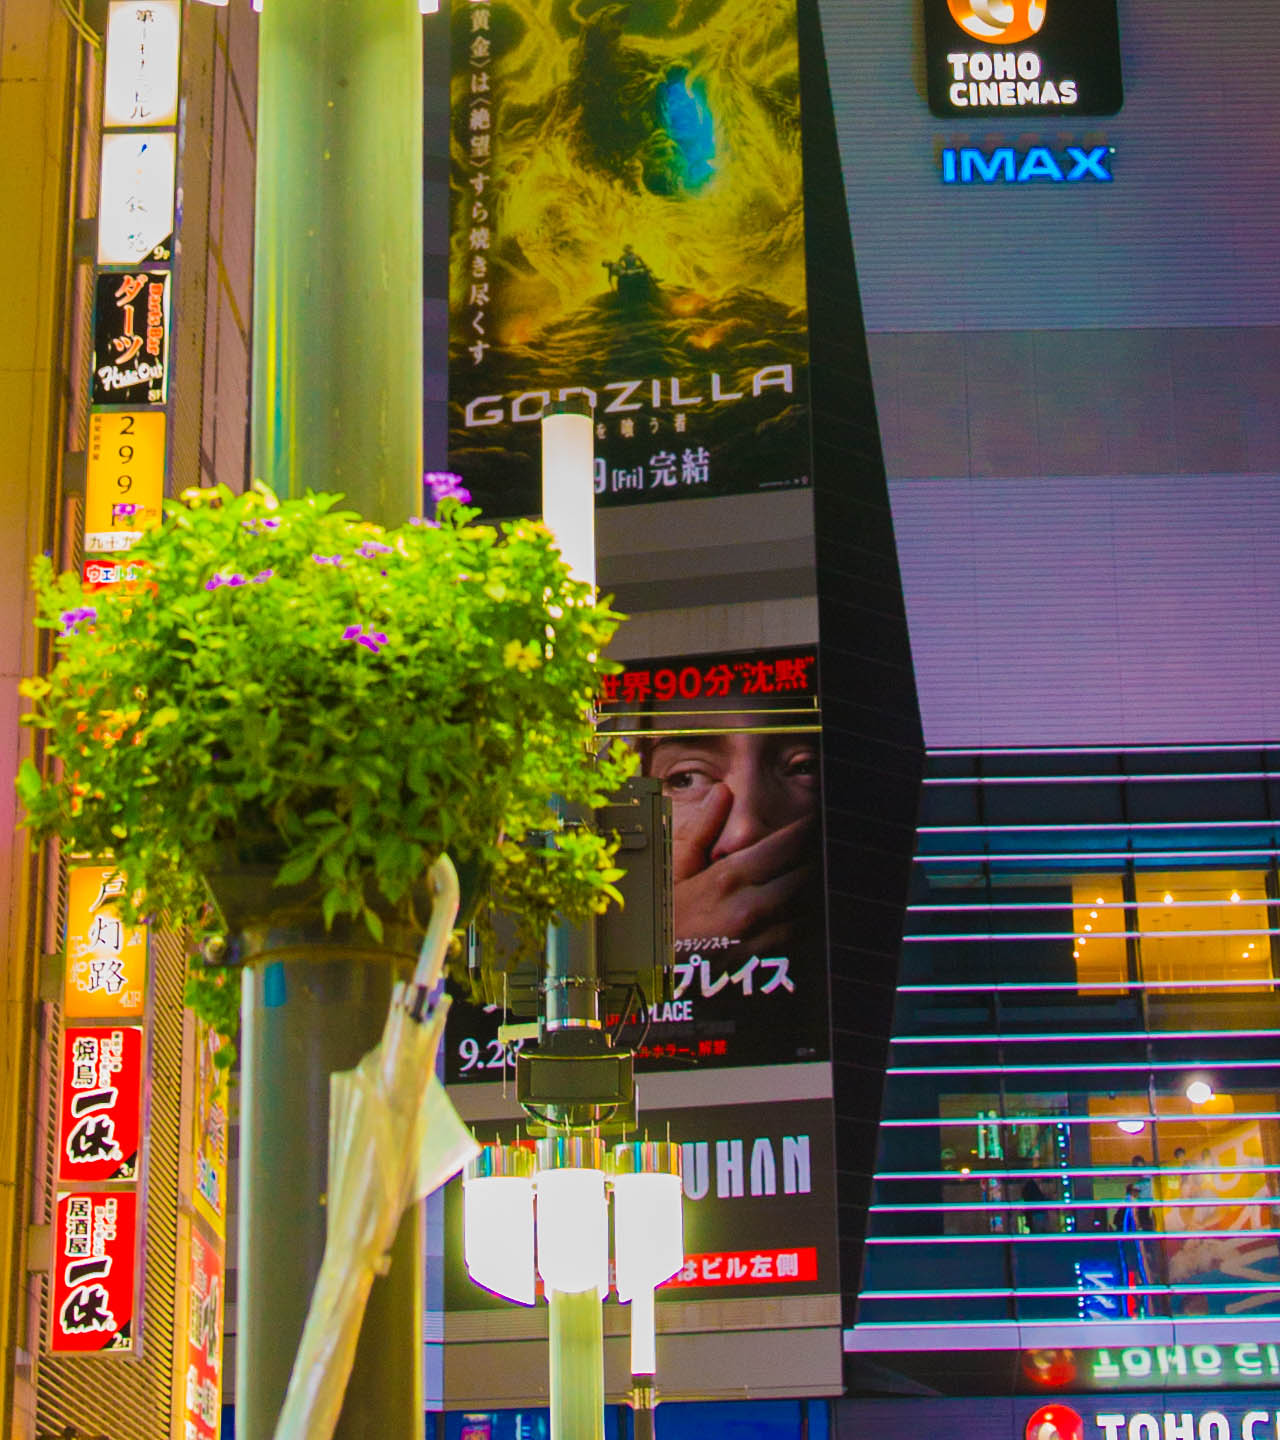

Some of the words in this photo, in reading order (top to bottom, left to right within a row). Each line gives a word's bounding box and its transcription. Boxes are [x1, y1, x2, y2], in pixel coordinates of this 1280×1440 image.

[947, 51, 1041, 80] TOHO
[949, 81, 1078, 106] CINEMAS
[941, 146, 1113, 183] IMAX
[114, 274, 148, 364] ダーツ
[649, 446, 711, 490] 完結
[72, 1036, 98, 1089] 焼鳥
